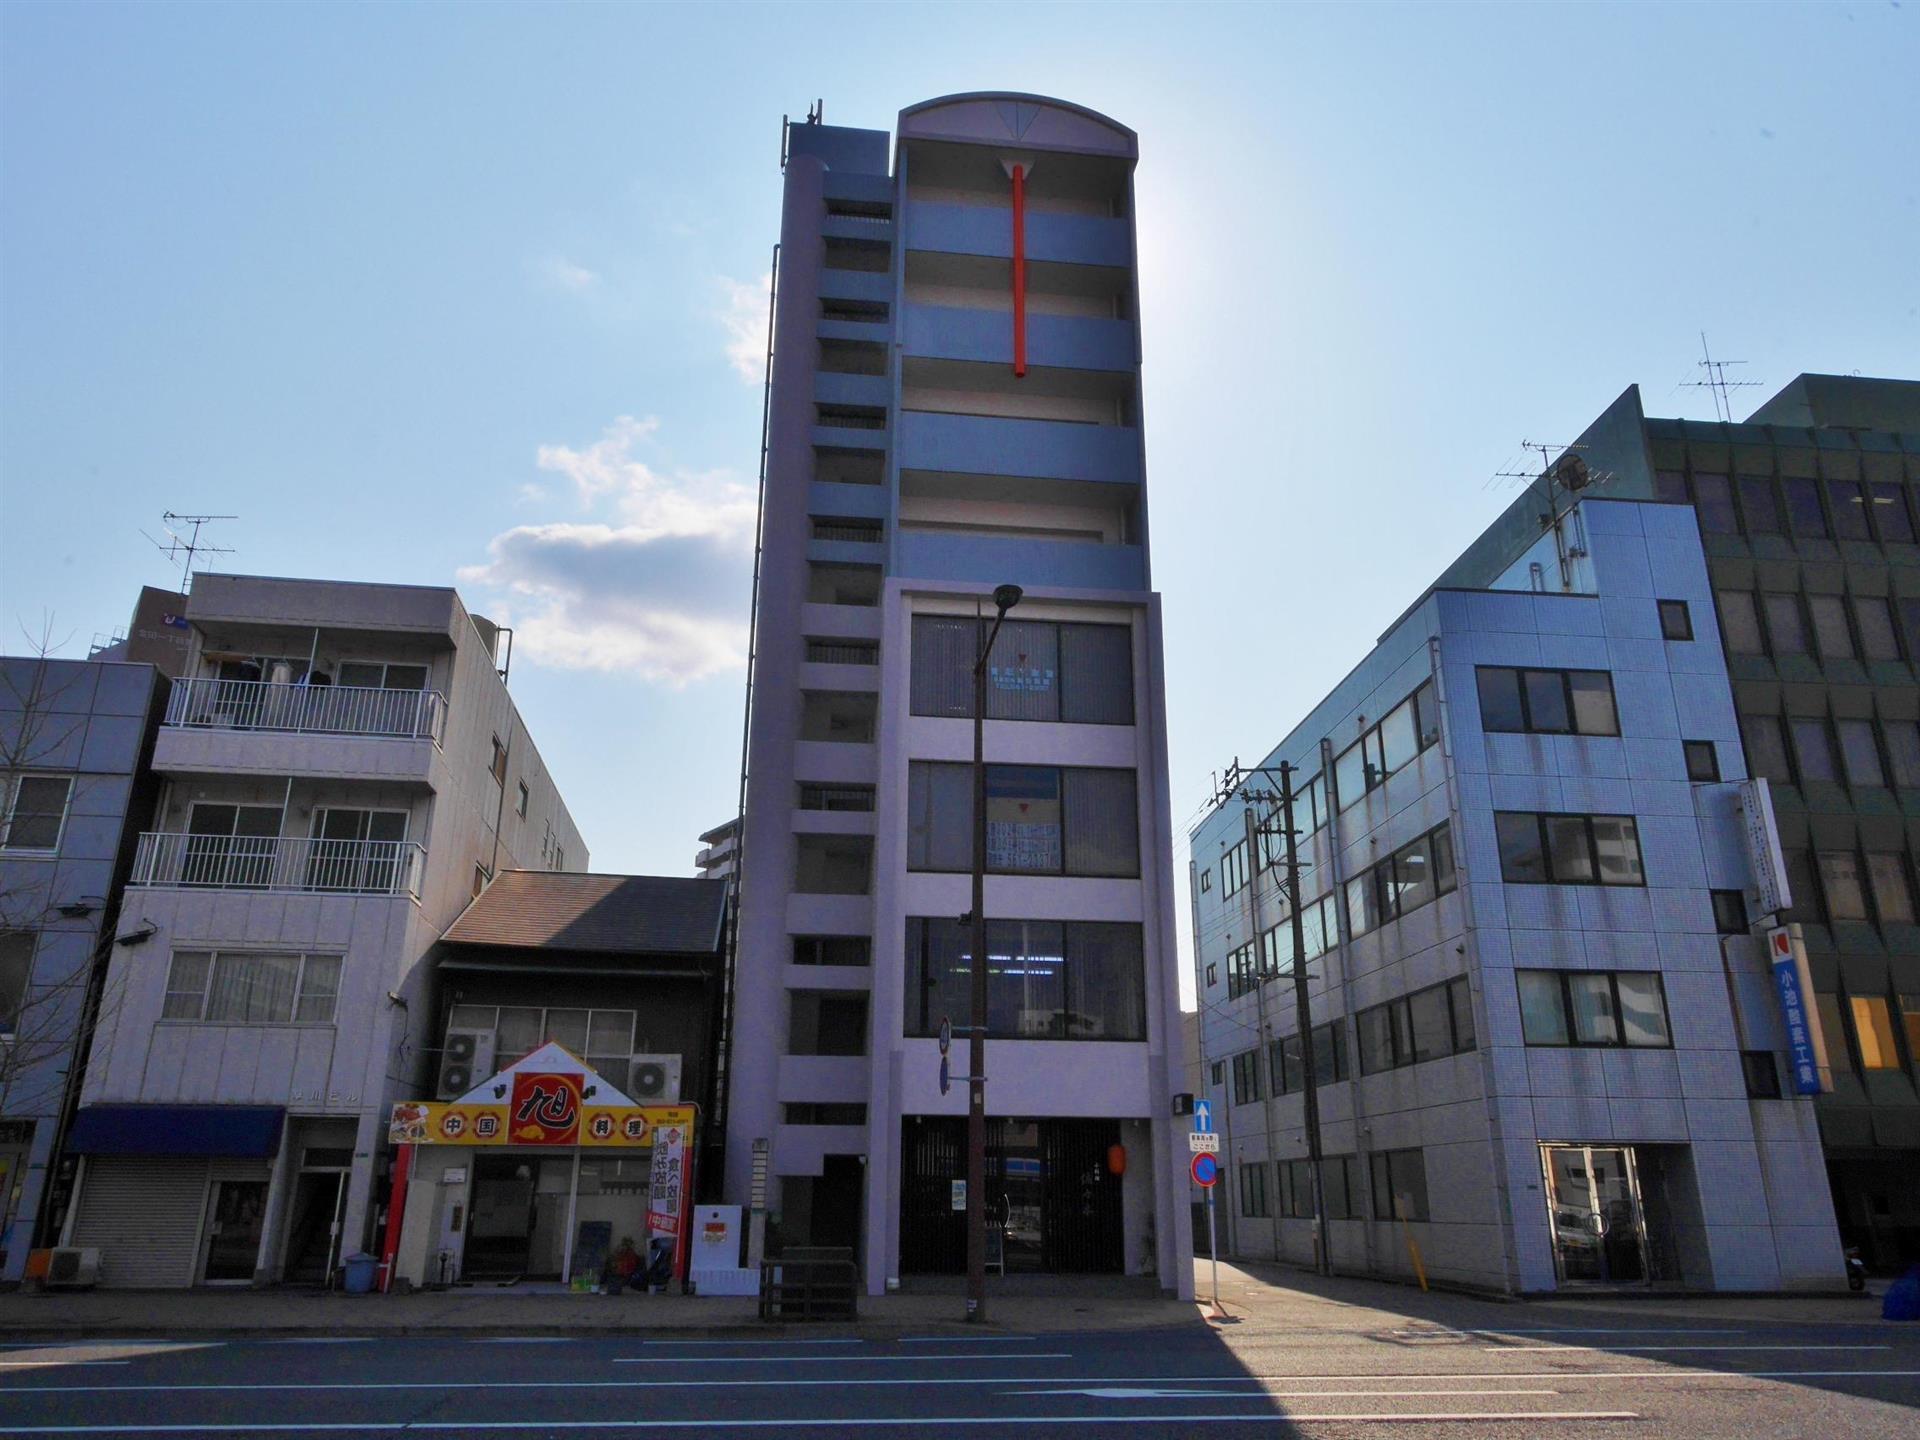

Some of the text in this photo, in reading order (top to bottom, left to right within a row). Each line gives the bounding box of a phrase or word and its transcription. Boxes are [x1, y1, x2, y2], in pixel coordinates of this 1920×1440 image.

[516, 1086, 575, 1128] 旭
[445, 1117, 642, 1136] 中国 料理
